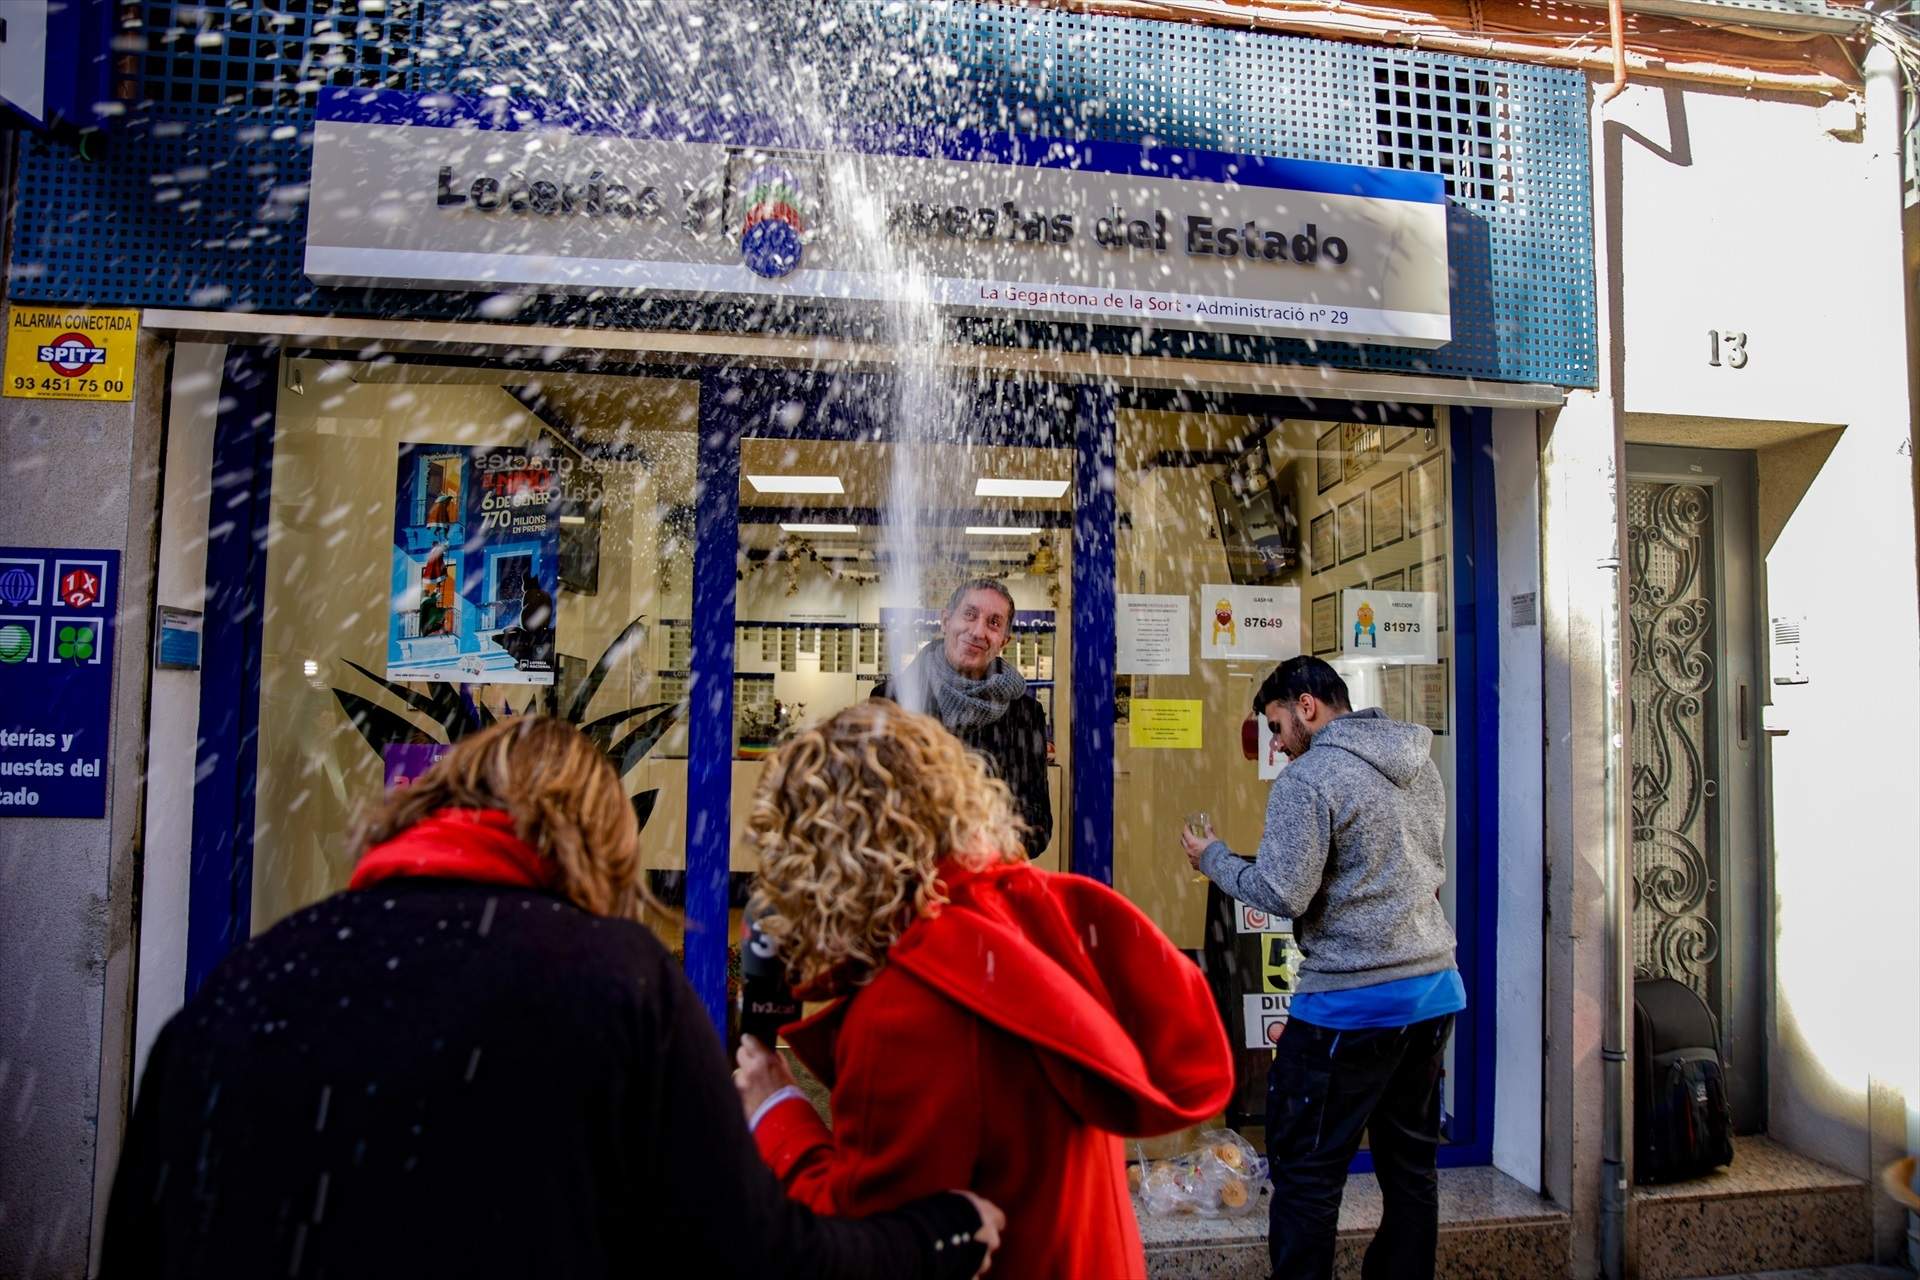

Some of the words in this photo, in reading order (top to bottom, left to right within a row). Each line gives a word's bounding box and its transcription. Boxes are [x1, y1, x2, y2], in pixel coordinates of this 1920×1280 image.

[1095, 206, 1167, 250] del
[1186, 214, 1349, 265] Estado
[981, 286, 998, 300] La
[1005, 287, 1098, 306] Gegantona
[1104, 293, 1123, 308] de
[1130, 294, 1143, 309] la
[1149, 297, 1182, 312] Sort
[1196, 300, 1305, 321] Administració
[1331, 310, 1349, 325] 29
[14, 313, 62, 328] ALARMA
[65, 315, 132, 331] CONECTADA
[40, 346, 105, 363] SPITZ
[1707, 329, 1749, 369] 13
[15, 377, 36, 390] 93
[41, 378, 70, 391] 451
[79, 379, 98, 392] 75
[104, 380, 123, 392] 00
[481, 490, 495, 510] 6
[496, 495, 511, 509] DE
[481, 510, 512, 529] 770
[512, 515, 547, 524] MILIONS
[1244, 618, 1283, 629] 87649
[1384, 622, 1421, 633] 81973
[61, 733, 74, 752] y
[1, 759, 64, 777] uestas
[70, 758, 101, 777] del
